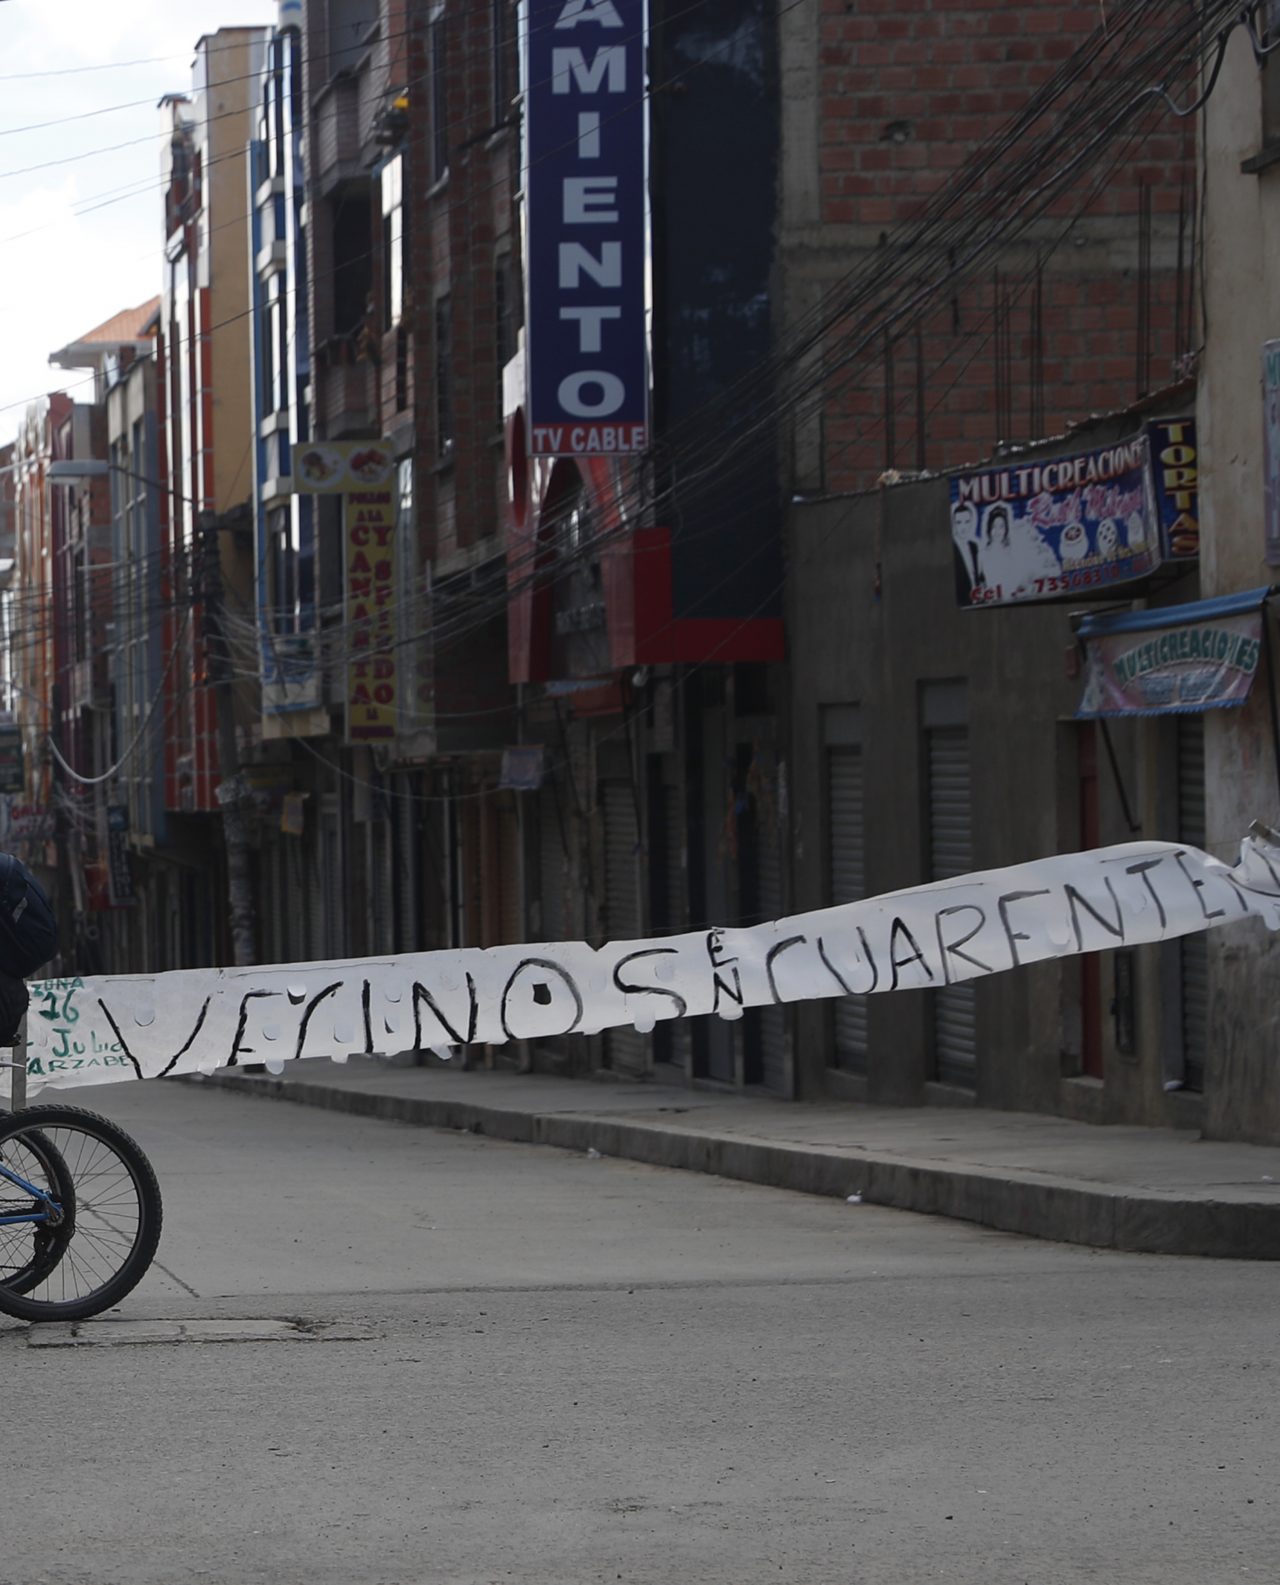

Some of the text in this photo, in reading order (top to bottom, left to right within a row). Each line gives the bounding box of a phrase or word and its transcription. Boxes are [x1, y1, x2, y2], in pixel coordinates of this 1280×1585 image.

[534, 426, 645, 452] TV CABLE
[1157, 421, 1199, 555] TORTAS
[39, 989, 79, 1023] 16
[98, 948, 686, 1078] VECINOS
